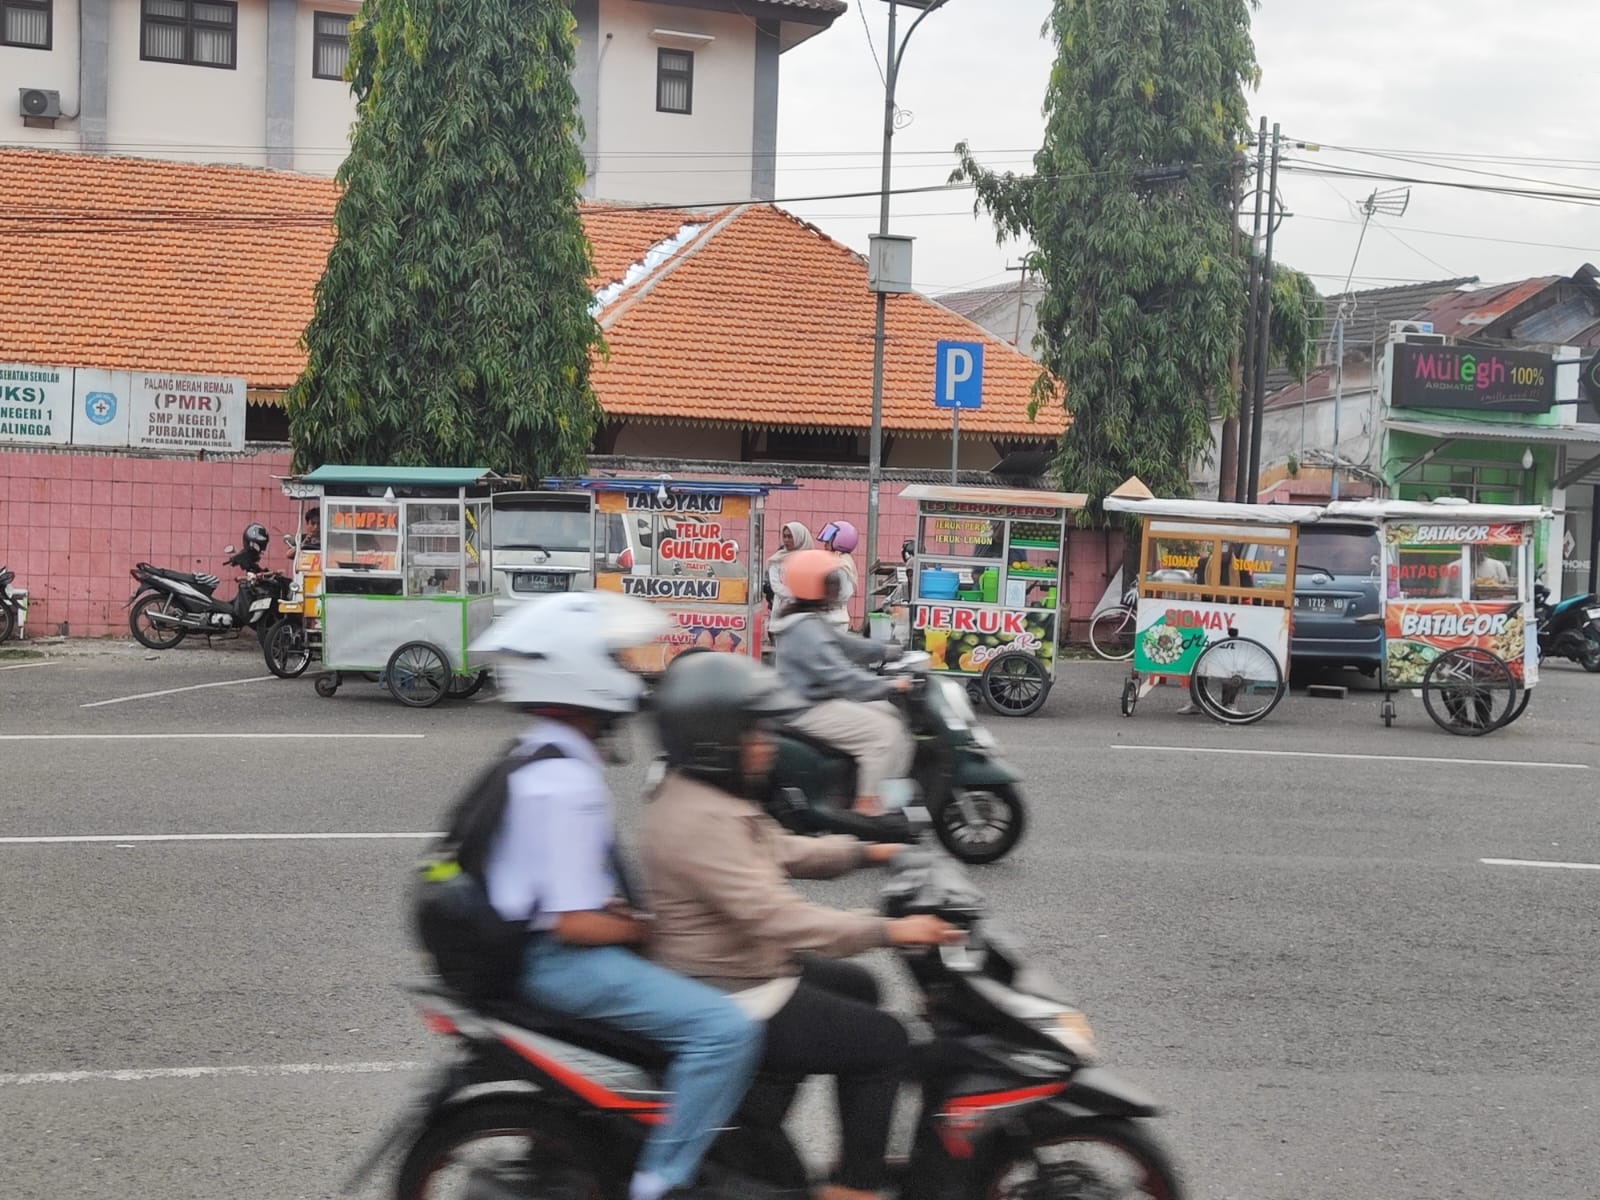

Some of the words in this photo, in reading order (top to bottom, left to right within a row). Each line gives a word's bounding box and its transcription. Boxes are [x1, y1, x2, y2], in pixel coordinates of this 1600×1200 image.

[30, 371, 60, 383] SEKOLAH
[946, 348, 973, 401] P
[1510, 367, 1545, 386] 100%
[144, 377, 174, 391] PALANG
[176, 379, 202, 393] MERAH
[204, 382, 234, 395] REMAJA
[1425, 381, 1474, 391] AROMATIC
[1, 407, 41, 419] NEGERI
[47, 409, 52, 420] 1
[149, 412, 173, 424] SMP
[178, 414, 217, 426] NEGERI
[222, 416, 227, 427] 1
[148, 425, 226, 440] PURBALINGGA
[625, 493, 723, 513] TAKOYAKI
[949, 501, 1000, 514] JERUK
[1005, 504, 1057, 517] PERAS
[675, 523, 721, 539] TELUR
[935, 520, 961, 531] JERUK
[1417, 524, 1490, 541] BATAGOR
[935, 535, 960, 544] JERUK
[963, 536, 993, 546] LEMON
[1161, 554, 1200, 569] SIOMAY
[1232, 557, 1272, 573] SIOMAY
[622, 577, 720, 599] TAKOYAKI
[668, 612, 745, 630] ULUNG
[914, 606, 1027, 635] JERUK
[1165, 608, 1236, 631] SIOMAY
[1401, 612, 1509, 637] BATAGOR
